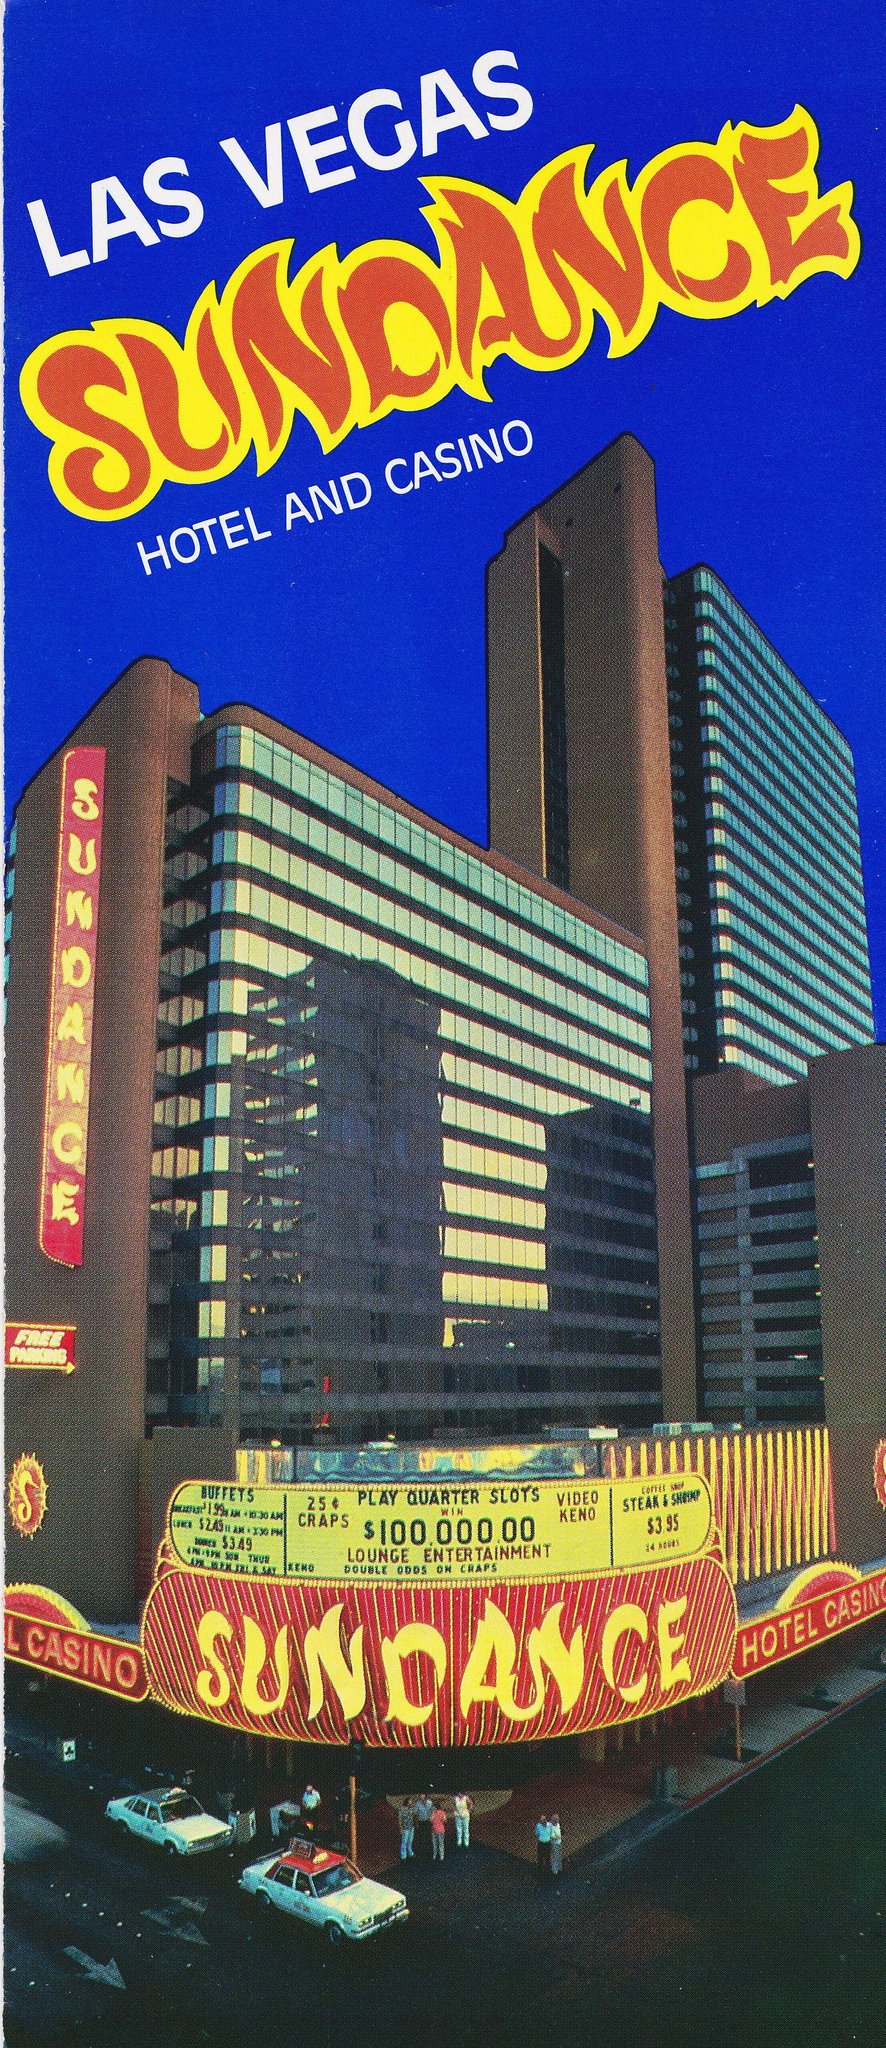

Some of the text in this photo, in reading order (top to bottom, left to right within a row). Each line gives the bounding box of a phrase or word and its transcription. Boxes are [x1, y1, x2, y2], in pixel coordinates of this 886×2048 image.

[52, 778, 99, 1225] SUNDANCE
[14, 1329, 65, 1347] FREE
[201, 1485, 254, 1502] BUFFETS
[358, 1485, 540, 1506] PLAY QUARTER SLOTS
[557, 1490, 599, 1507] VIDEO
[440, 1508, 464, 1516] WIN
[623, 1494, 660, 1512] STEAK
[298, 1512, 349, 1528] CRAPS
[560, 1507, 596, 1523] KENO
[347, 1543, 551, 1563] LOUNGE ENTERTAINMENT
[287, 1562, 315, 1573] KENO
[344, 1562, 497, 1575] DOUBLE ODDS ON CRAPS
[742, 1609, 818, 1668] HOTEL
[26, 1625, 138, 1689] CASINO
[196, 1596, 692, 1727] SUNDANCE
